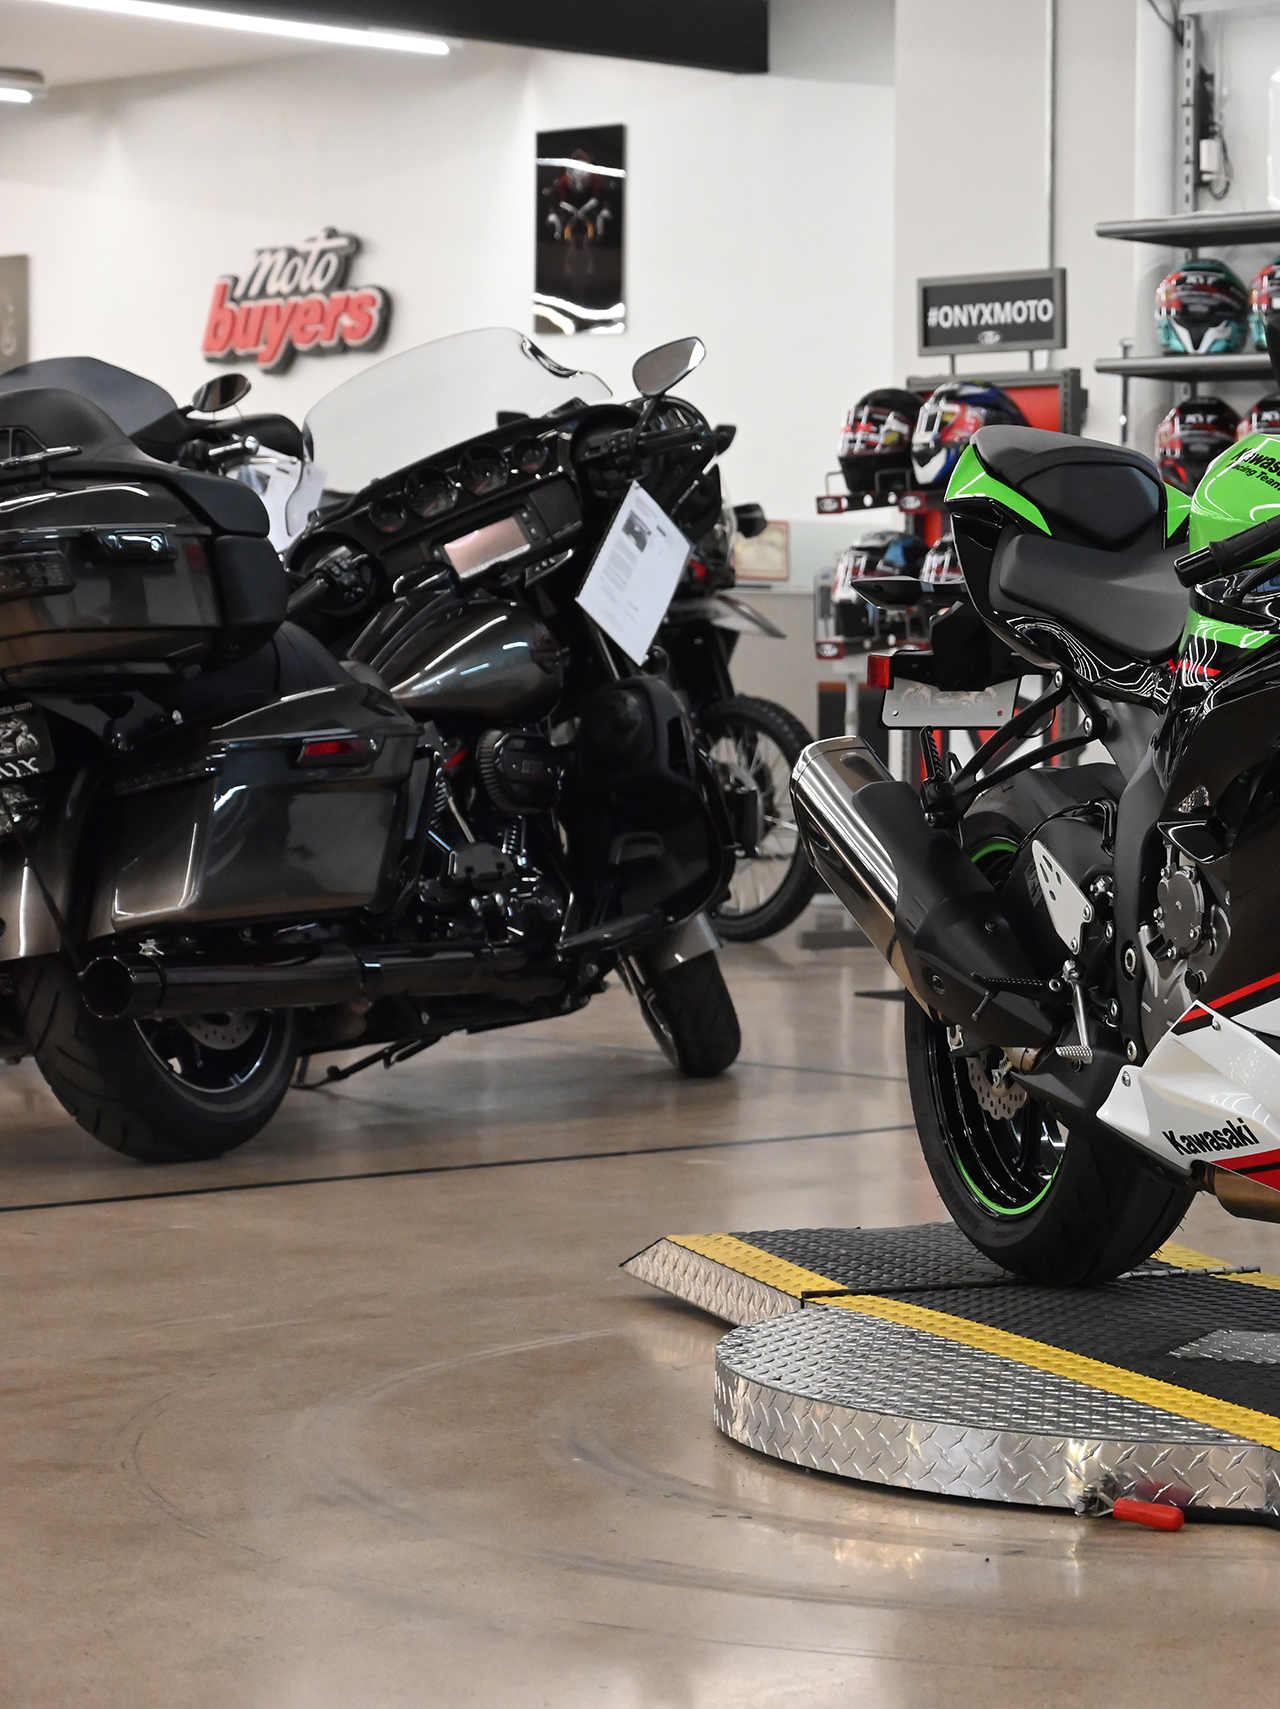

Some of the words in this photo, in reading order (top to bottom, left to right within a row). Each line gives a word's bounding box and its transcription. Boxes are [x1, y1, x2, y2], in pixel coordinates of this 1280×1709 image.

[202, 279, 378, 365] buyers
[927, 298, 1054, 329] #ONYXMOTO
[1162, 1117, 1260, 1156] Kawasaki
